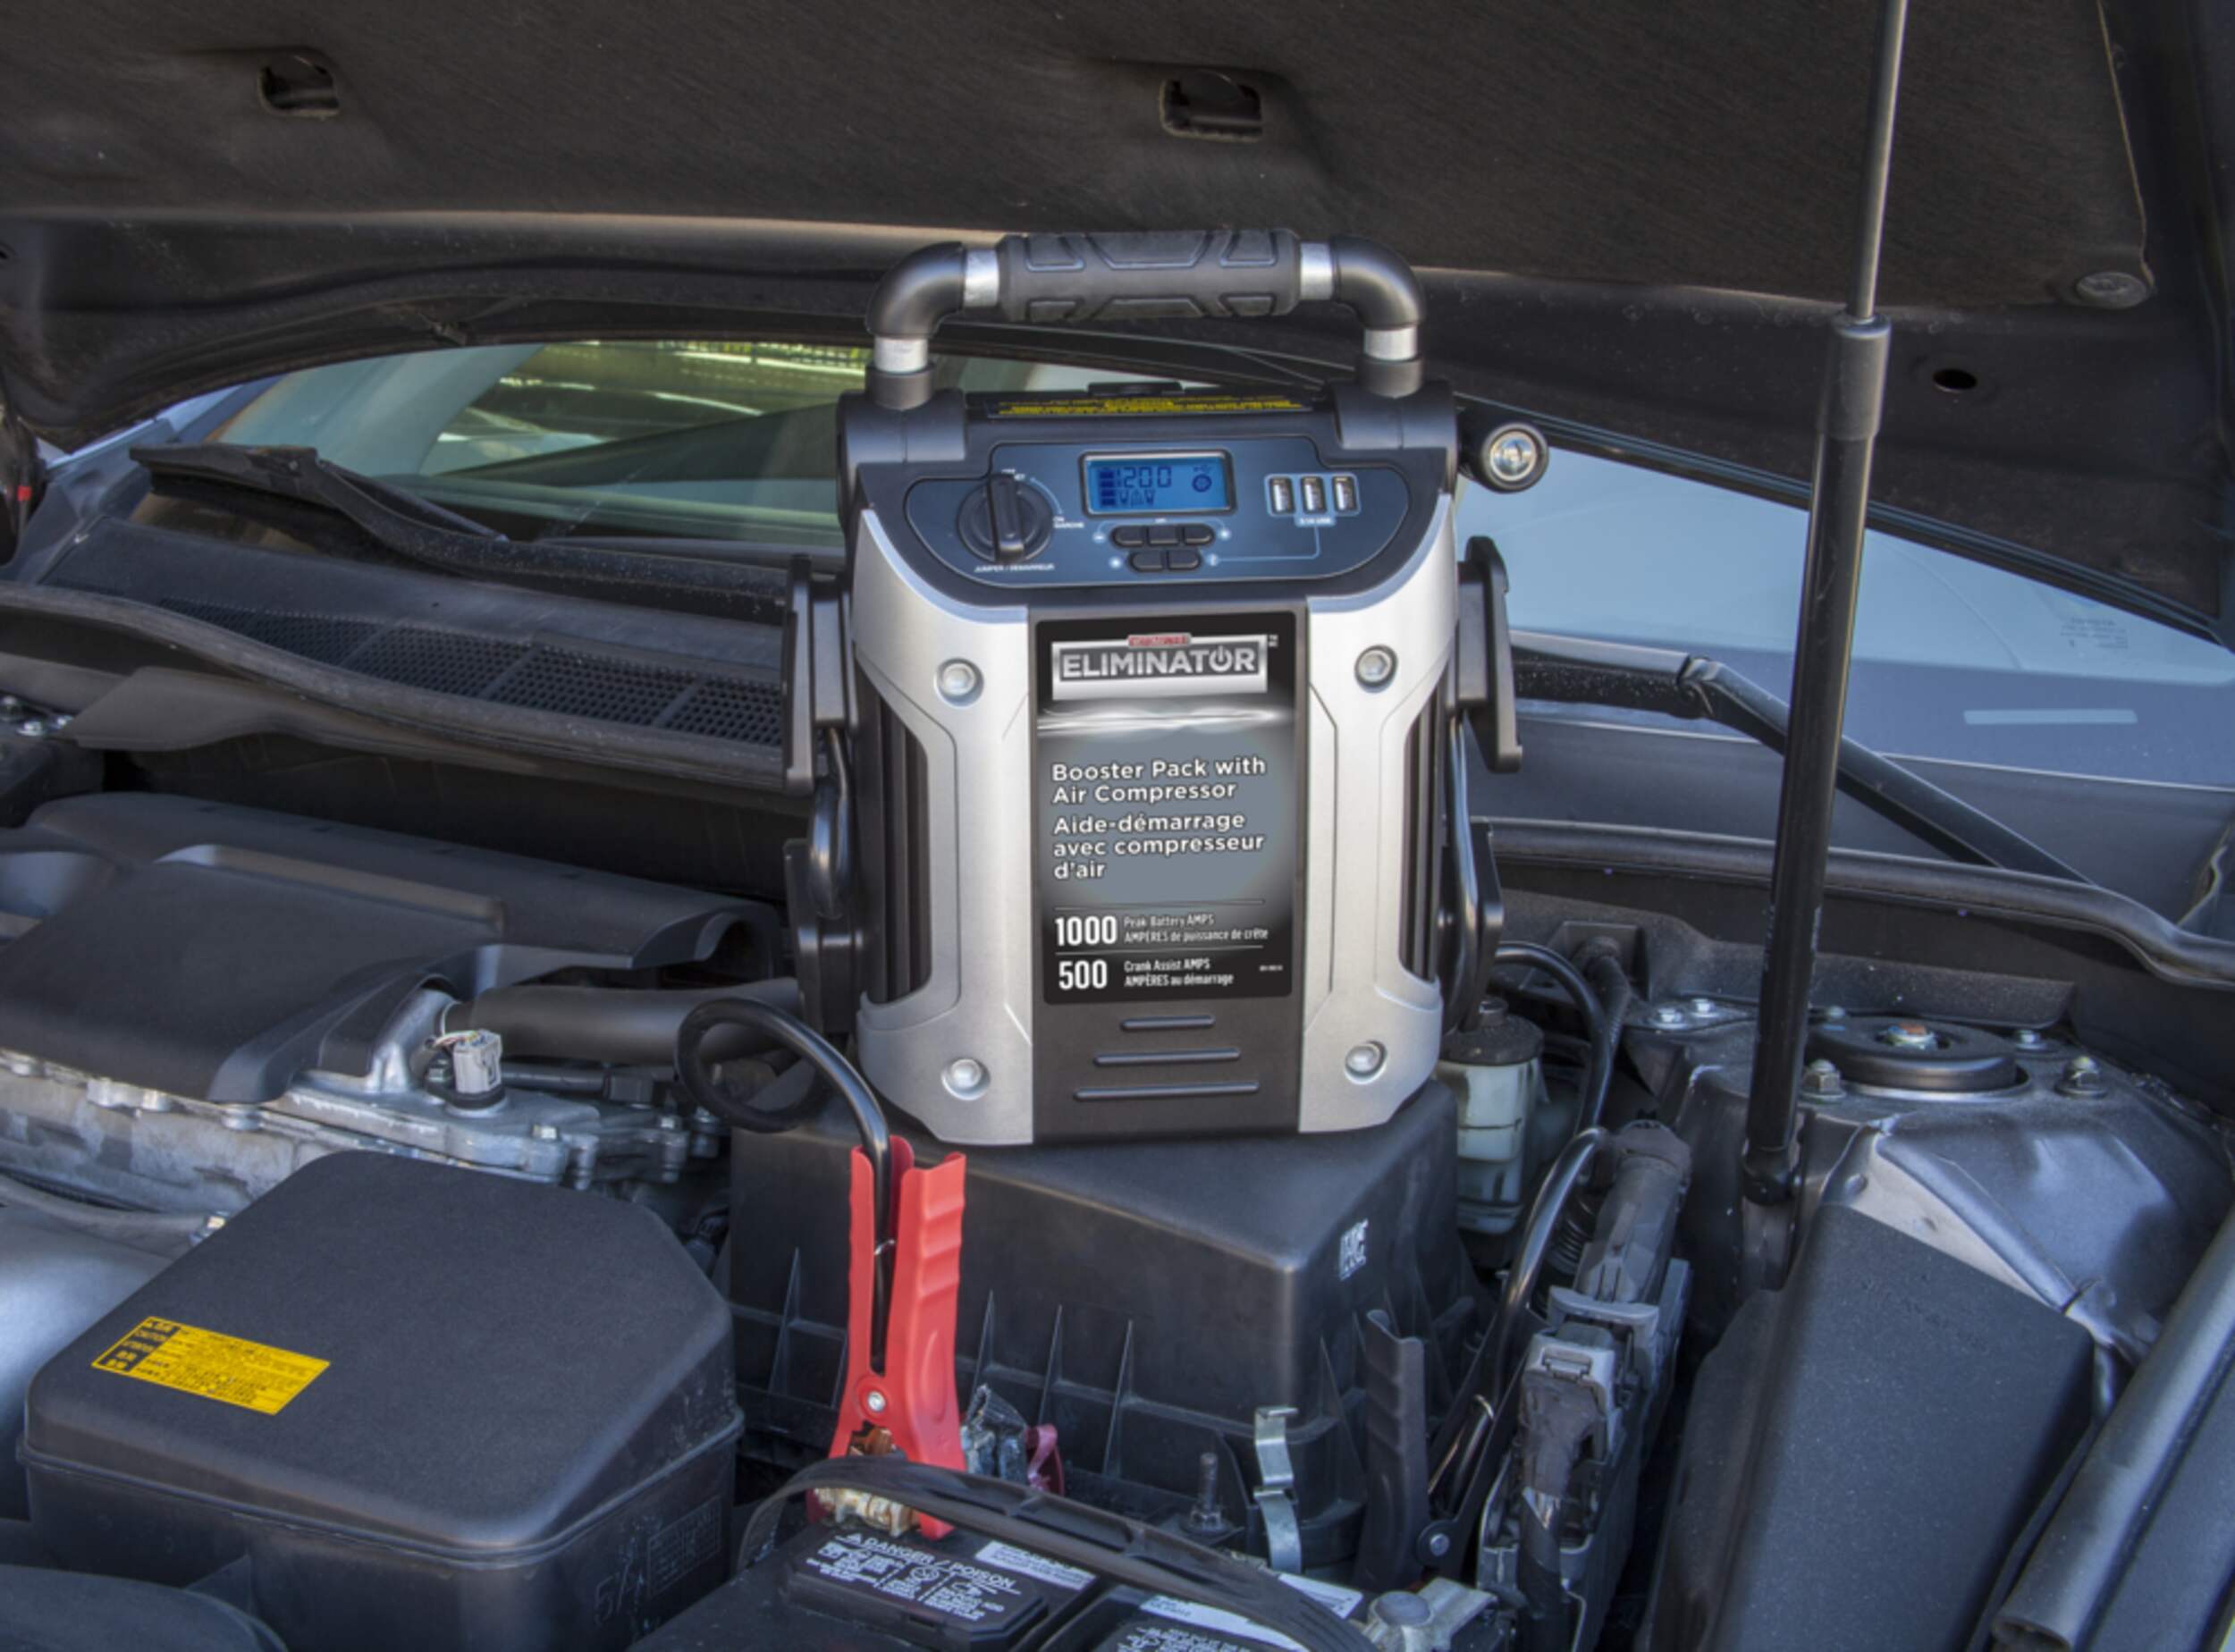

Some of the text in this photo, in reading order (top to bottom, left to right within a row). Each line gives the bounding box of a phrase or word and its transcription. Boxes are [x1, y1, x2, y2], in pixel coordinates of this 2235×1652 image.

[1062, 645, 1256, 678] ELIMINATOR
[1051, 756, 1267, 782] Booster Pack with
[1053, 782, 1238, 805] Air Compressor
[1053, 813, 1246, 836] Aide-démarrage
[1054, 836, 1266, 858] avec compresseur
[1054, 860, 1107, 880] d'air
[1055, 914, 1118, 947] 1000
[1124, 913, 1215, 928] Peak Battery AMPS
[1171, 931, 1182, 943] de
[1184, 929, 1229, 943] puissance
[1231, 929, 1243, 940] de
[1058, 959, 1109, 990] 500
[1124, 957, 1211, 973] Crank Assist AMPS
[1170, 976, 1182, 986] au
[1184, 973, 1235, 987] démarrage
[864, 1537, 935, 1564] DANGER
[949, 1563, 1017, 1589] POISON
